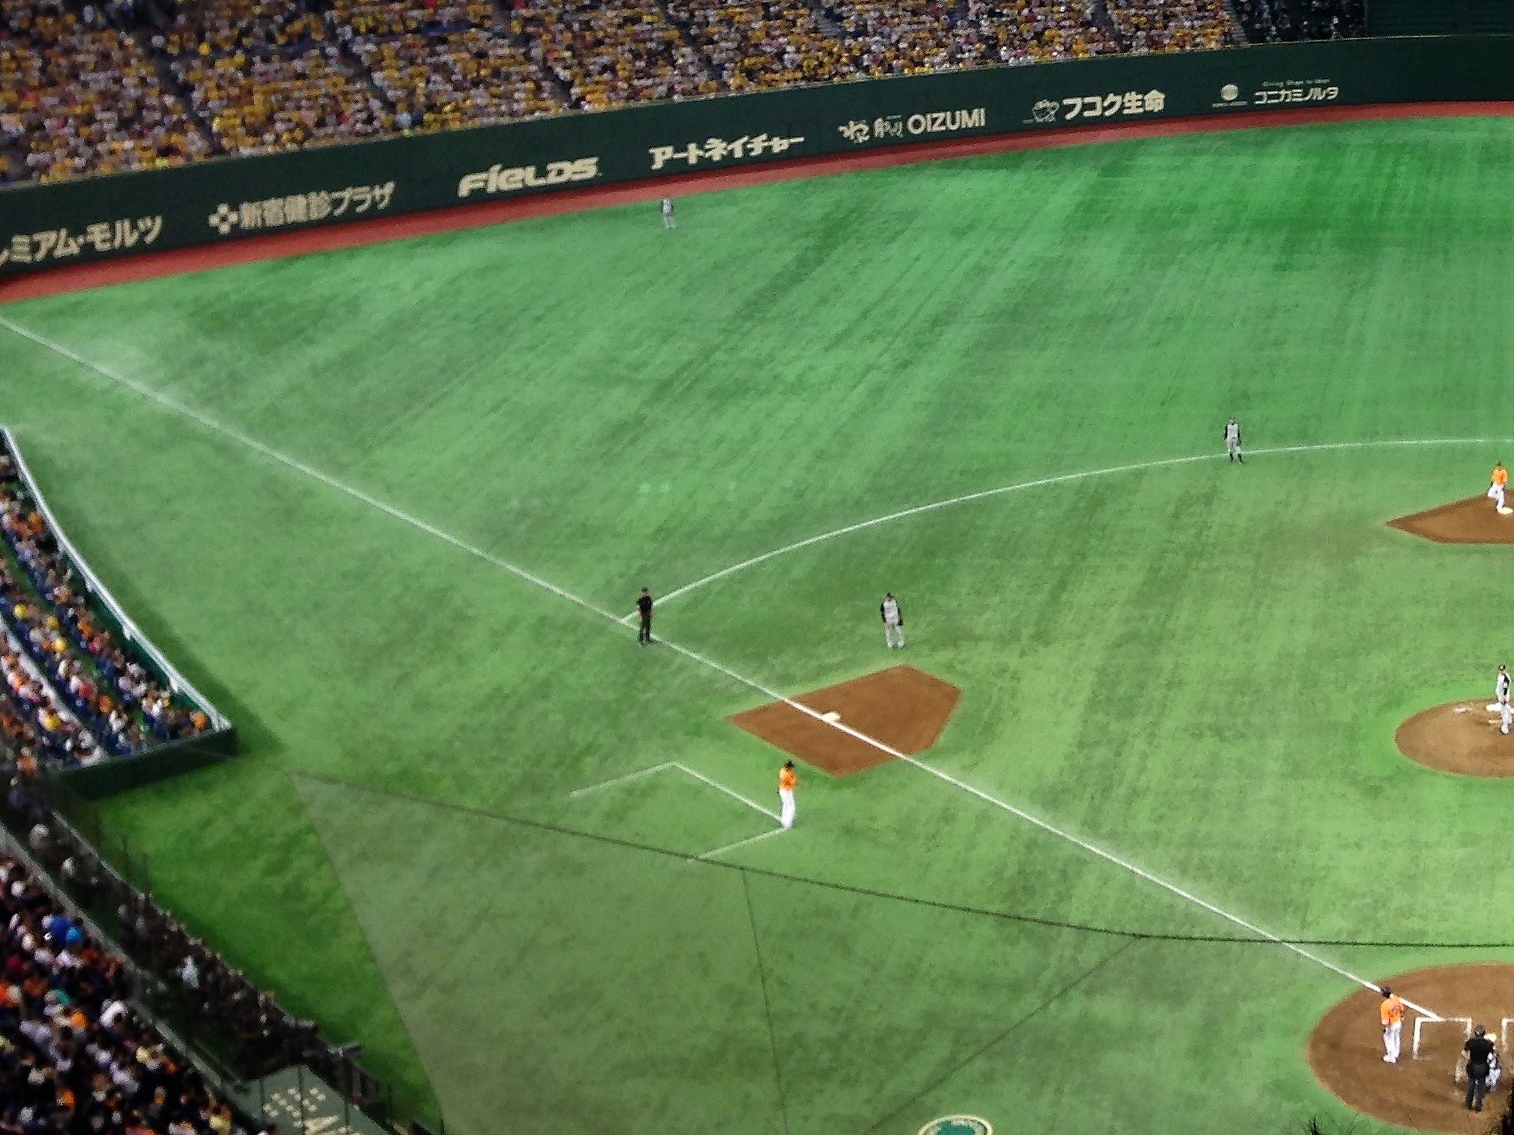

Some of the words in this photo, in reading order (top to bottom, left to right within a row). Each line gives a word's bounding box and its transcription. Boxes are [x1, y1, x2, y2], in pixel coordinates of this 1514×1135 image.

[1062, 89, 1166, 121] フコク生命
[1254, 86, 1339, 105] コニカミノルタ
[906, 107, 986, 135] OIZUMI
[649, 133, 805, 170] アートネイチャー
